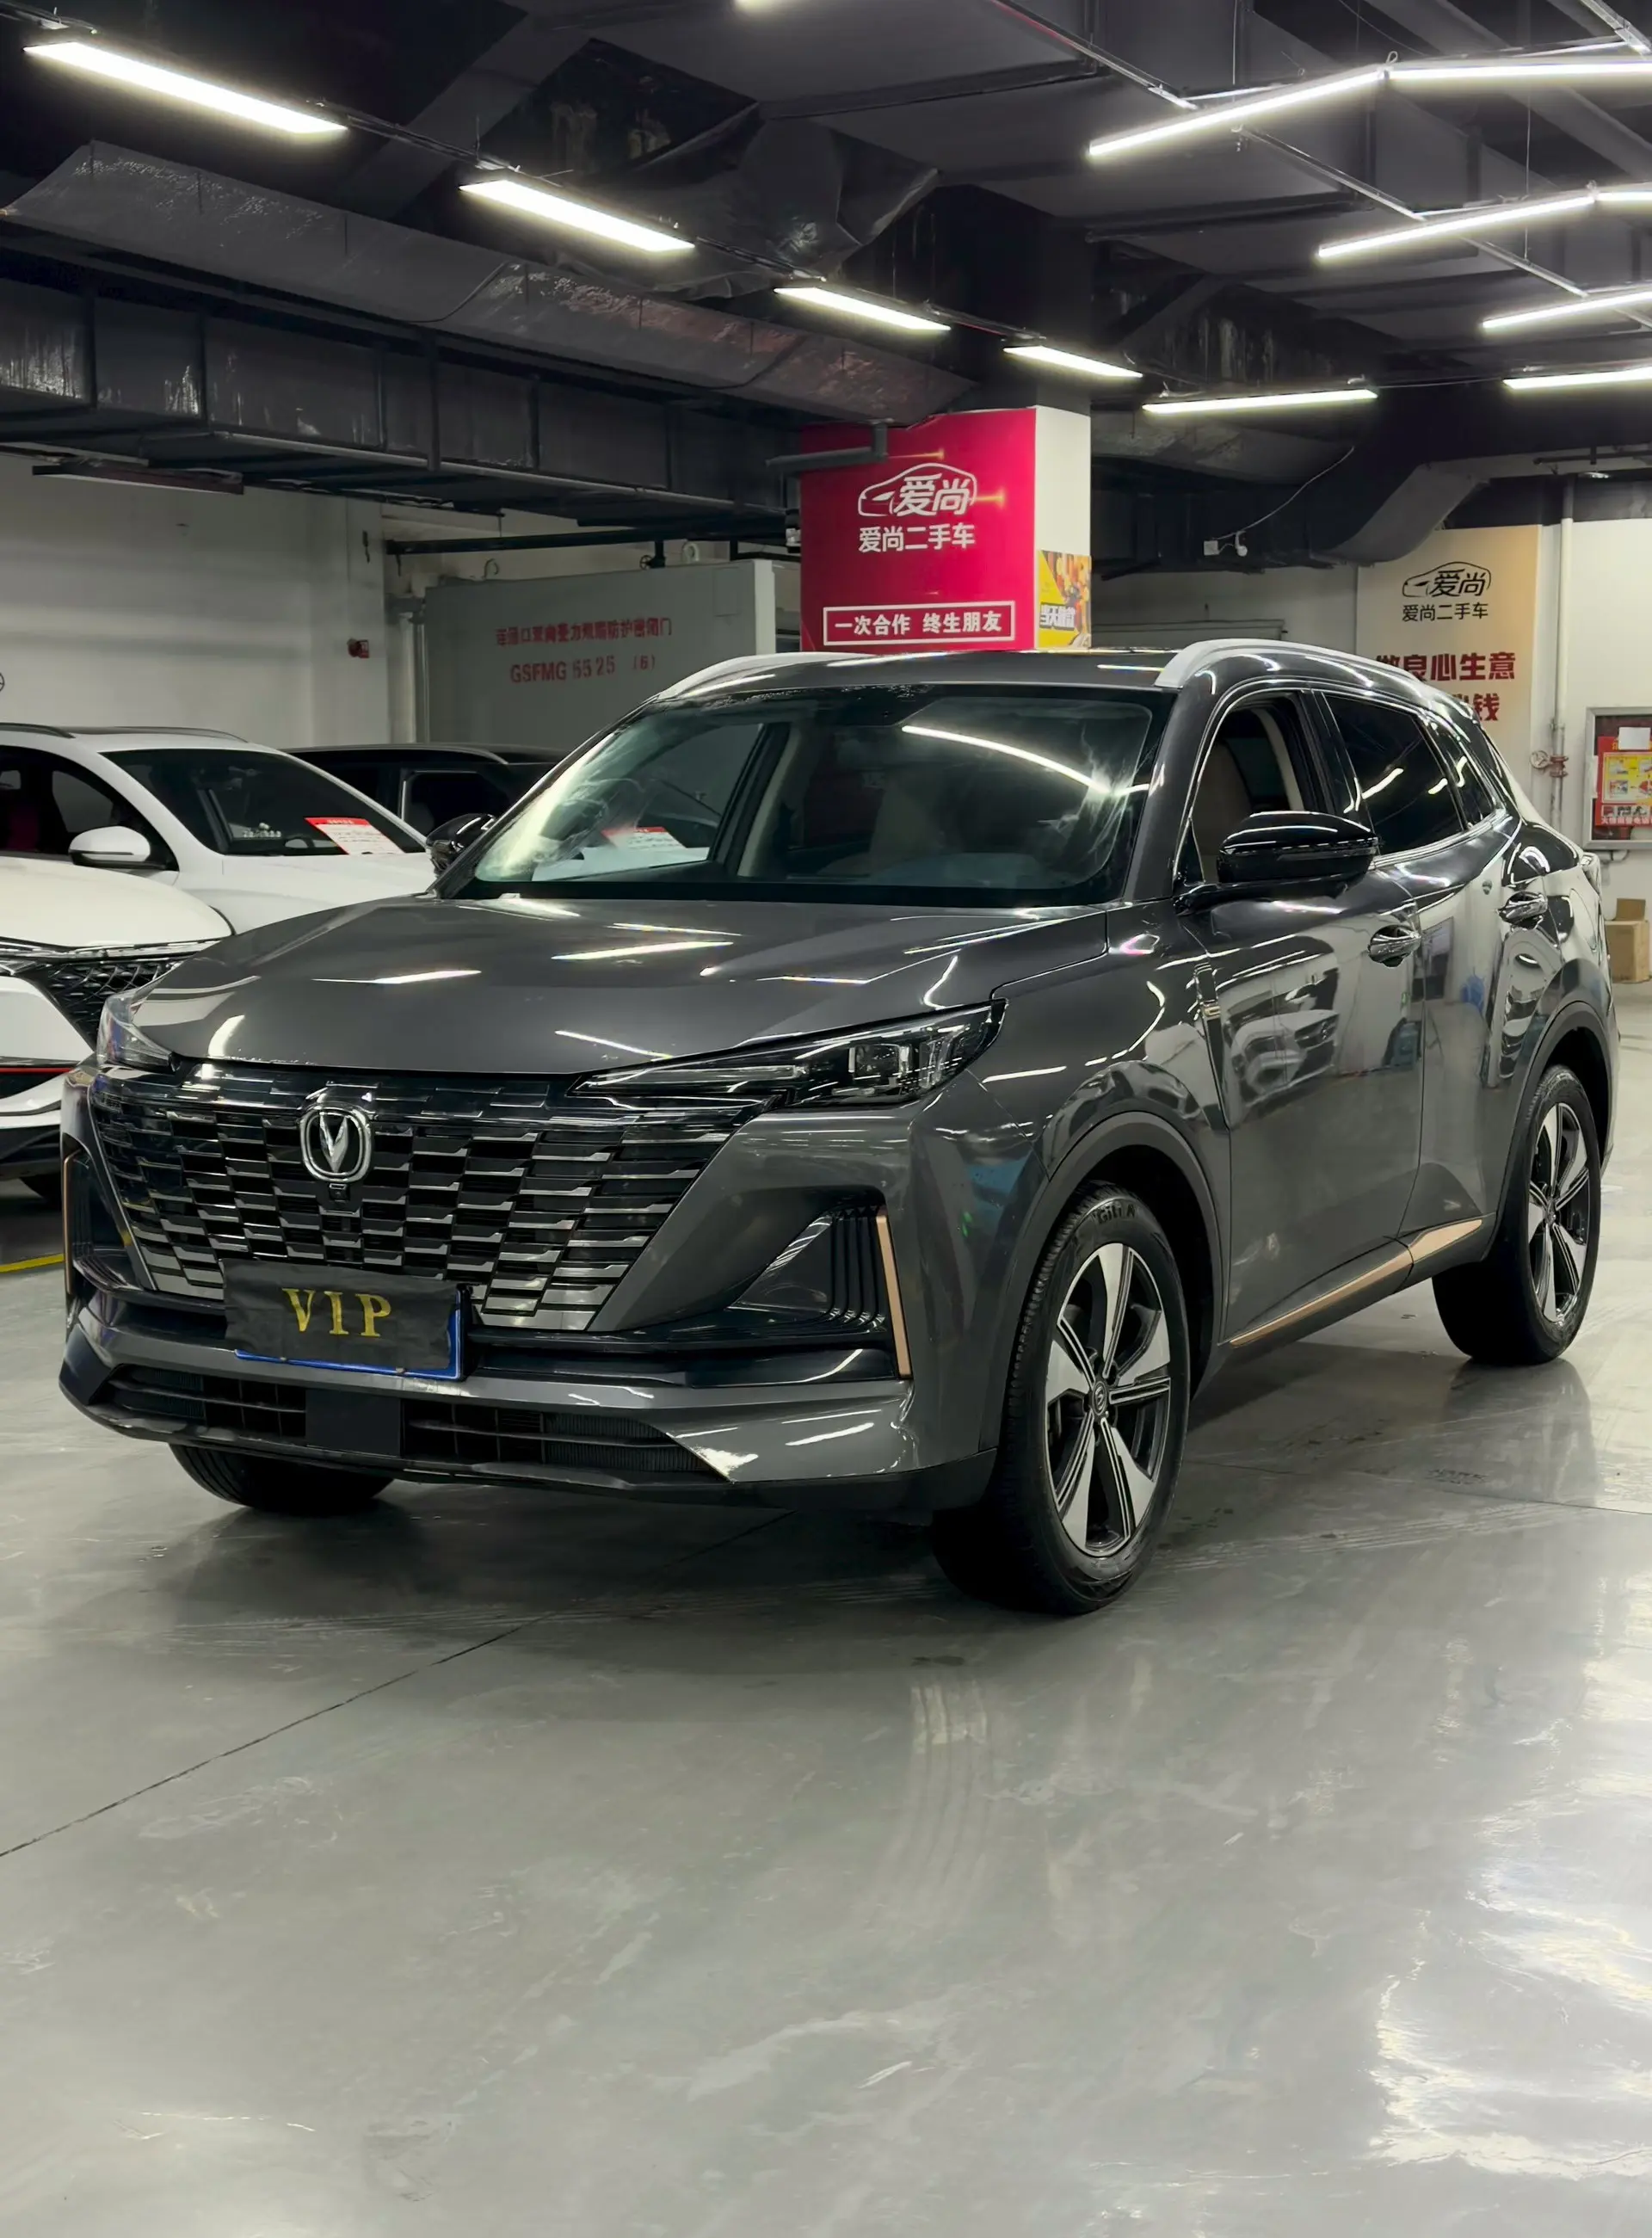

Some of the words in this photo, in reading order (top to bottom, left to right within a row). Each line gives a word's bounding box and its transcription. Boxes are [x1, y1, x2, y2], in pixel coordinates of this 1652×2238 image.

[893, 474, 971, 516] 爱尚
[859, 522, 976, 552] 爱尚二手车
[1428, 569, 1487, 597] 爱尚
[835, 613, 910, 636] 一次合作
[922, 609, 1002, 633] 终生朋友
[1402, 602, 1489, 621] 爱尚二手车
[509, 661, 567, 684] GSFMG
[281, 1288, 391, 1338] VIP
